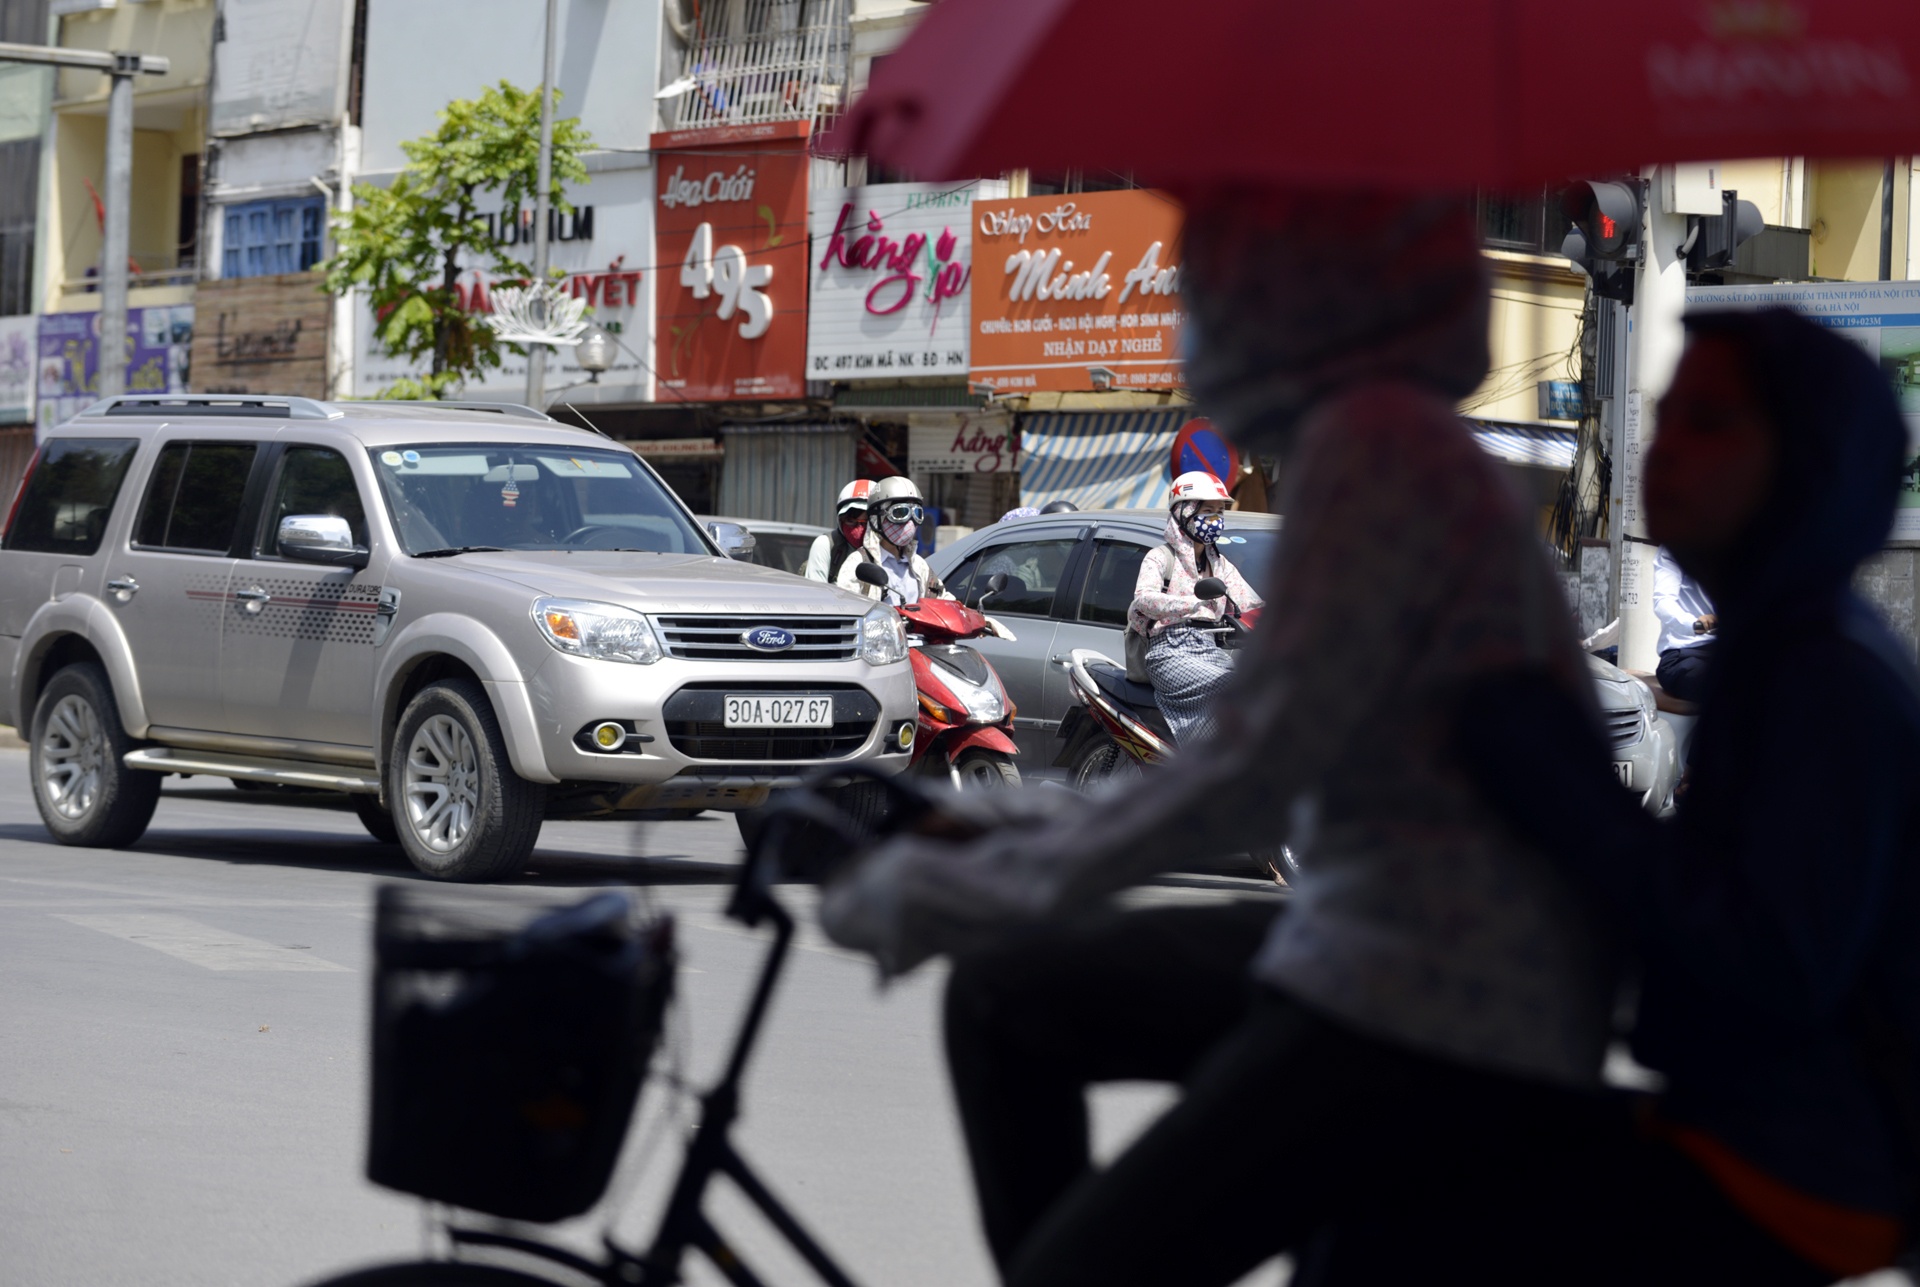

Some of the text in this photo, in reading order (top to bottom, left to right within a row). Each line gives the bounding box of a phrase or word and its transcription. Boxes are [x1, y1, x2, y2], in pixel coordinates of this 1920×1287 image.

[703, 164, 755, 203] Cưới
[907, 189, 972, 209] FLORIST
[980, 202, 1092, 244] Shop Hoa
[679, 222, 773, 339] 495
[1004, 247, 1112, 303] Minh
[1758, 292, 1774, 302] THỊ
[1817, 290, 1847, 300] THÀNH
[1849, 288, 1868, 299] PHỐ
[1870, 289, 1881, 299] HÀ
[1883, 288, 1900, 299] NỘI
[1815, 304, 1828, 312] GA
[1830, 302, 1842, 312] HÀ
[1844, 302, 1860, 312] NỘI
[1830, 317, 1845, 326] KM
[1847, 316, 1882, 326] 19+023M
[1043, 337, 1085, 359] NHẬN
[1087, 340, 1118, 357] DẠY
[855, 354, 874, 368] KIM
[877, 350, 894, 367] MÃ
[899, 353, 915, 367] NK
[947, 351, 963, 365] HN
[756, 630, 786, 646] Ford
[728, 700, 829, 724] 30A-027.67
